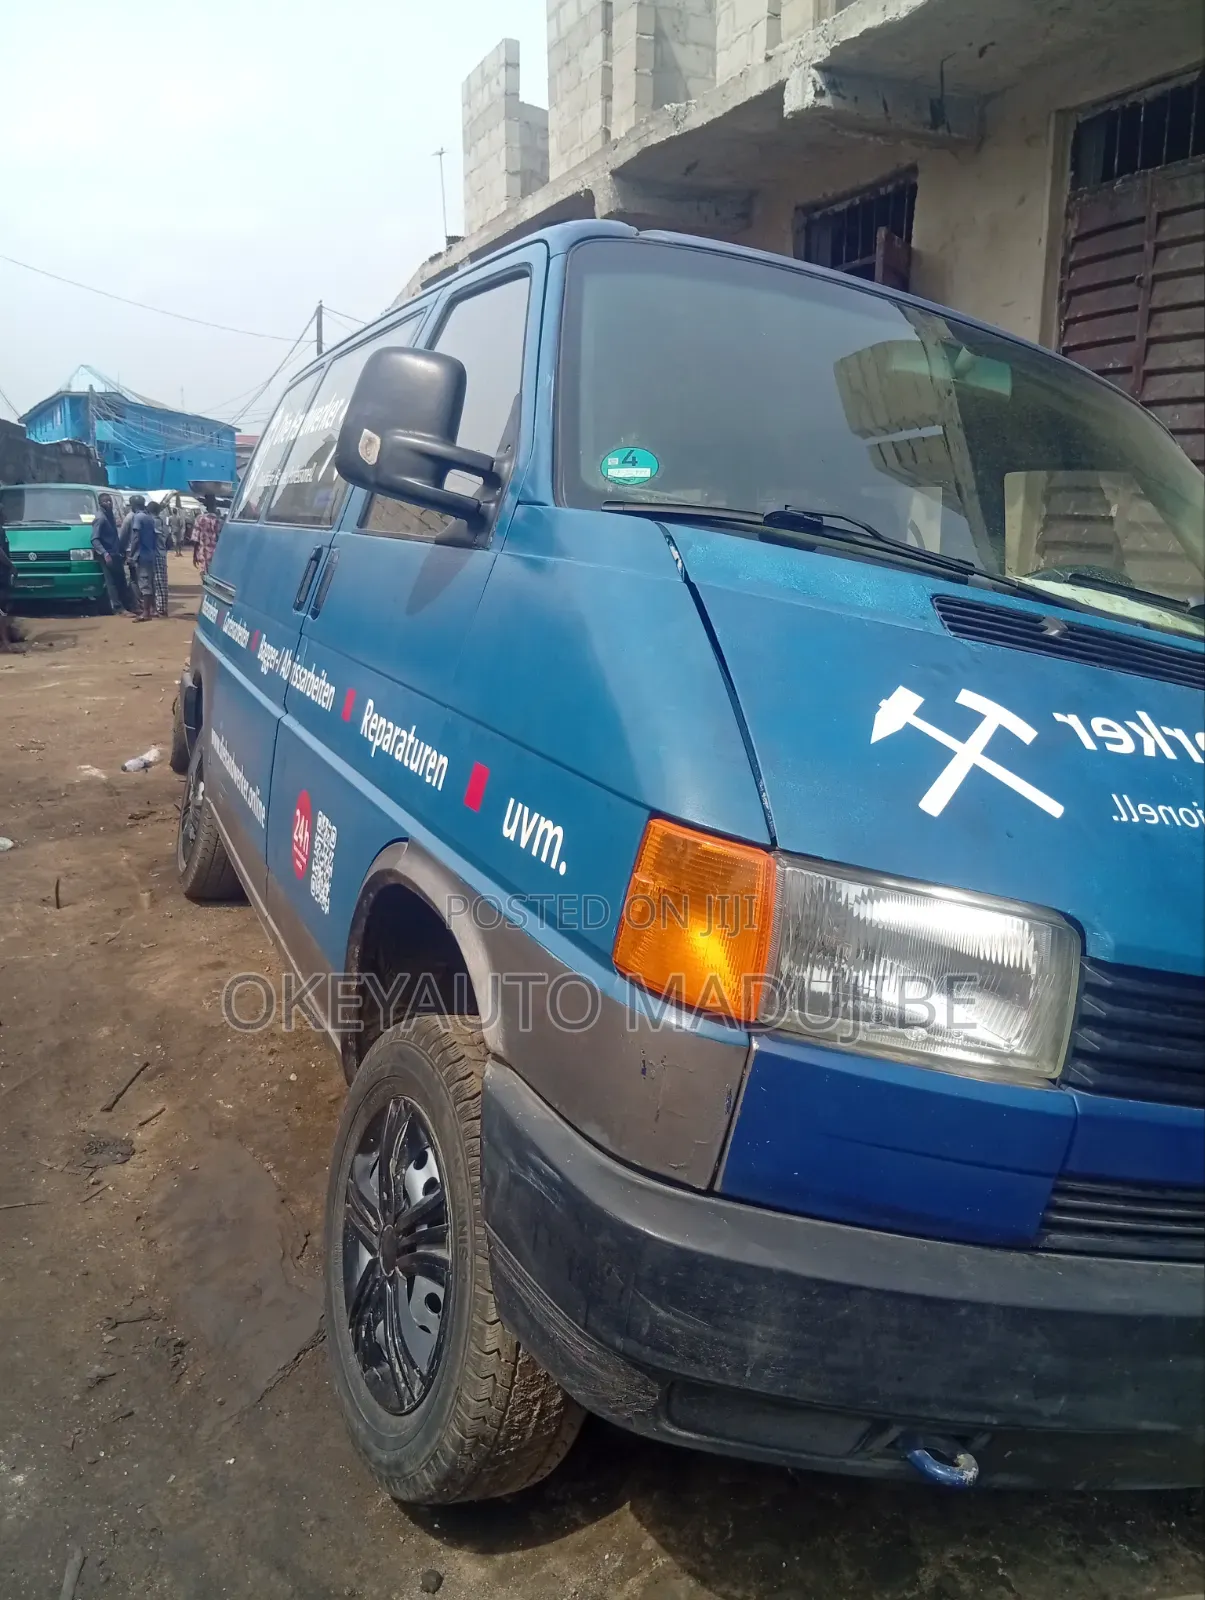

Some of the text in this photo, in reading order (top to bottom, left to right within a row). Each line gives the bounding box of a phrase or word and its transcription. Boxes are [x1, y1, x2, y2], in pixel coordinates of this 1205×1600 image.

[621, 449, 638, 467] 4
[360, 698, 449, 792] Reparaturen
[293, 808, 310, 855] 24h
[502, 797, 567, 876] uvm.
